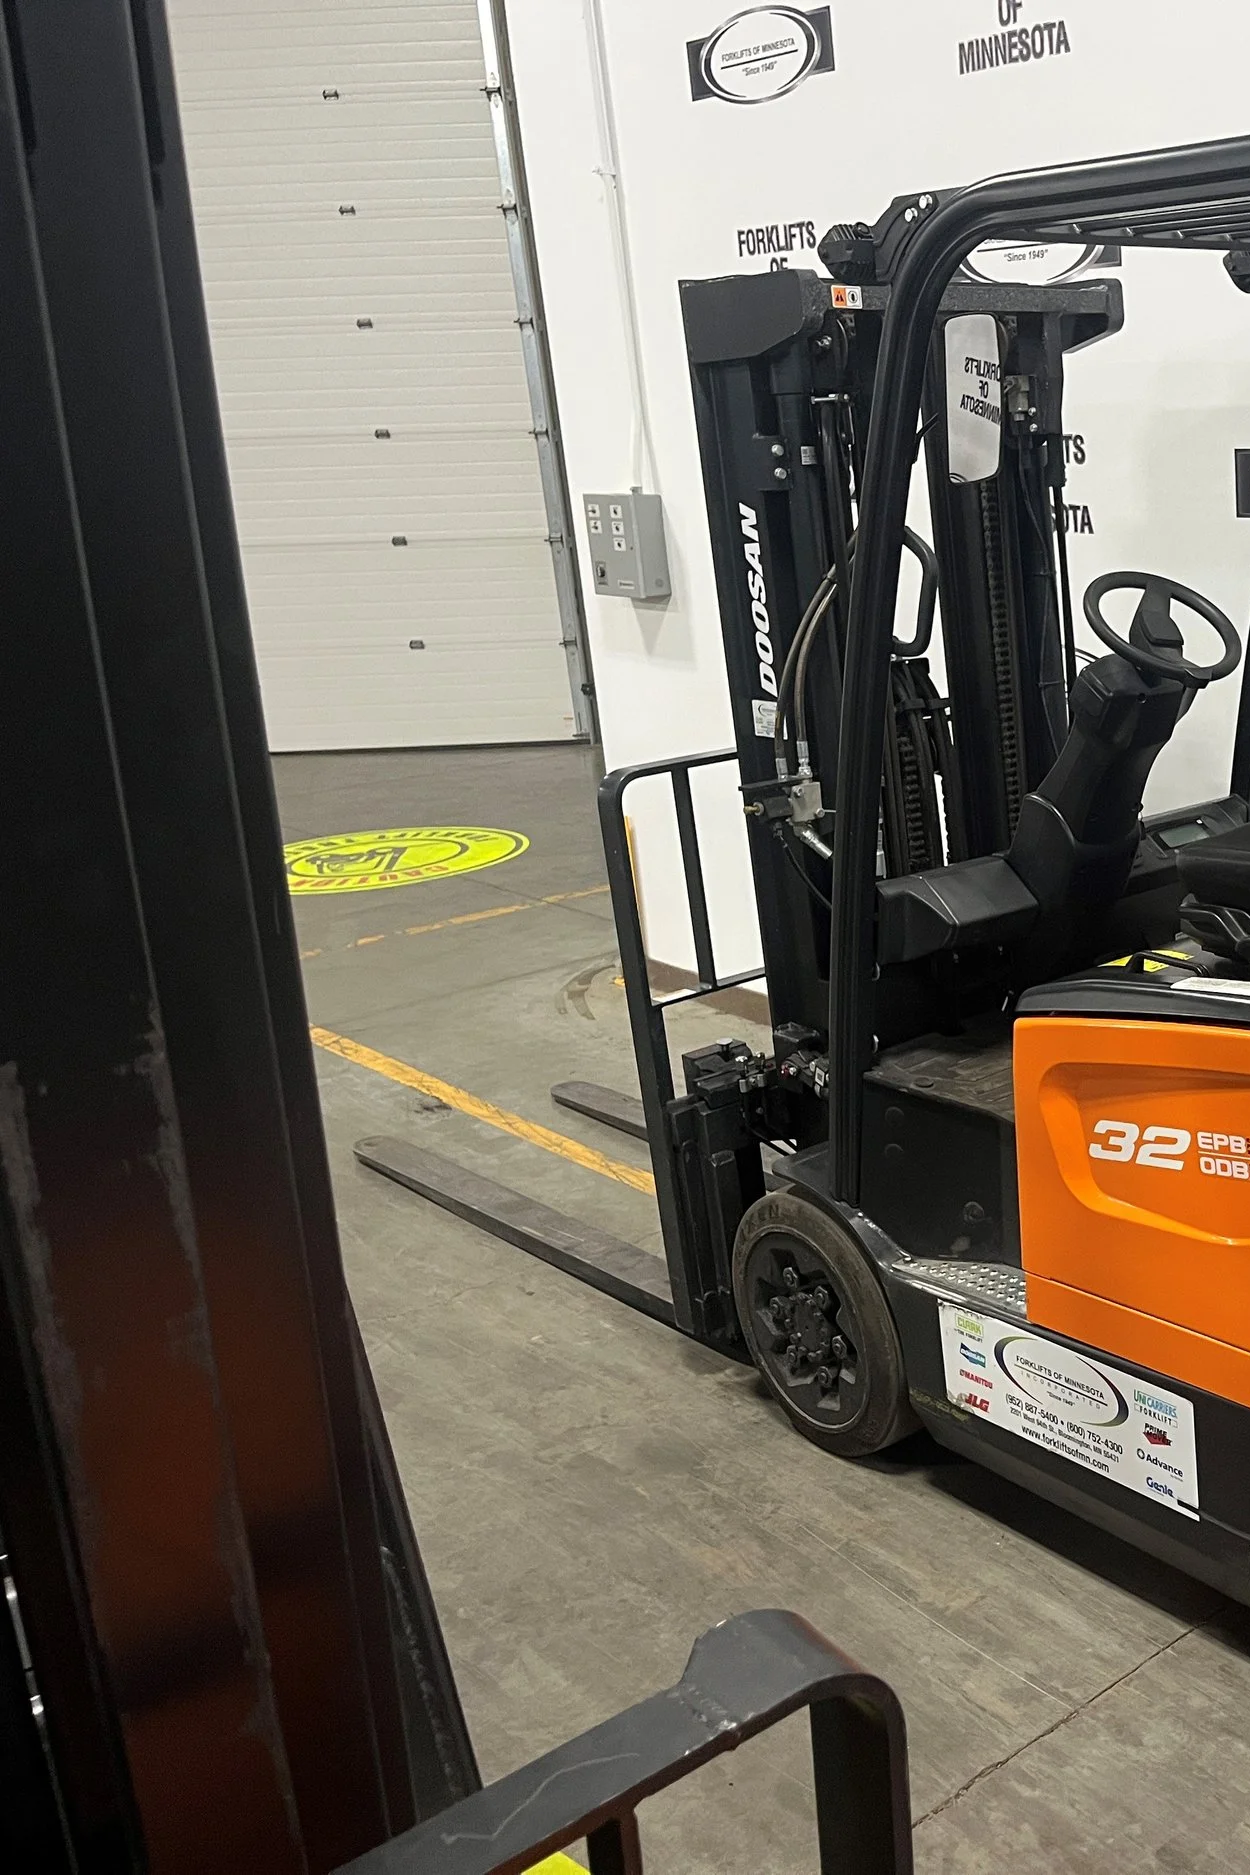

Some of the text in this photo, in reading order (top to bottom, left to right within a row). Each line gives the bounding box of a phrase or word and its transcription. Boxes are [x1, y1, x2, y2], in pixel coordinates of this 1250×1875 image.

[998, 0, 1023, 27] OF
[721, 38, 796, 62] FORKLIFTS OF MINNESOTA
[958, 20, 1071, 75] MINNESOTA
[737, 221, 817, 257] FORKLIFTS
[738, 502, 778, 698] DOOSAN
[1089, 1119, 1191, 1171] 32
[1197, 1131, 1247, 1154] EPB
[1199, 1157, 1250, 1180] ODB
[1016, 1355, 1105, 1400] FORKLIFTS OF MINNESOTA
[1020, 1370, 1101, 1410] INCORPORATED
[1005, 1393, 1024, 1411] (952)
[1087, 1430, 1122, 1455] 752-4300
[1139, 1405, 1172, 1426] FORKLIFT
[1144, 1422, 1168, 1438] PRIME
[1021, 1425, 1110, 1473] www.forkliftsofmn.com
[1146, 1454, 1184, 1477] Advance
[1146, 1477, 1174, 1498] Genie
